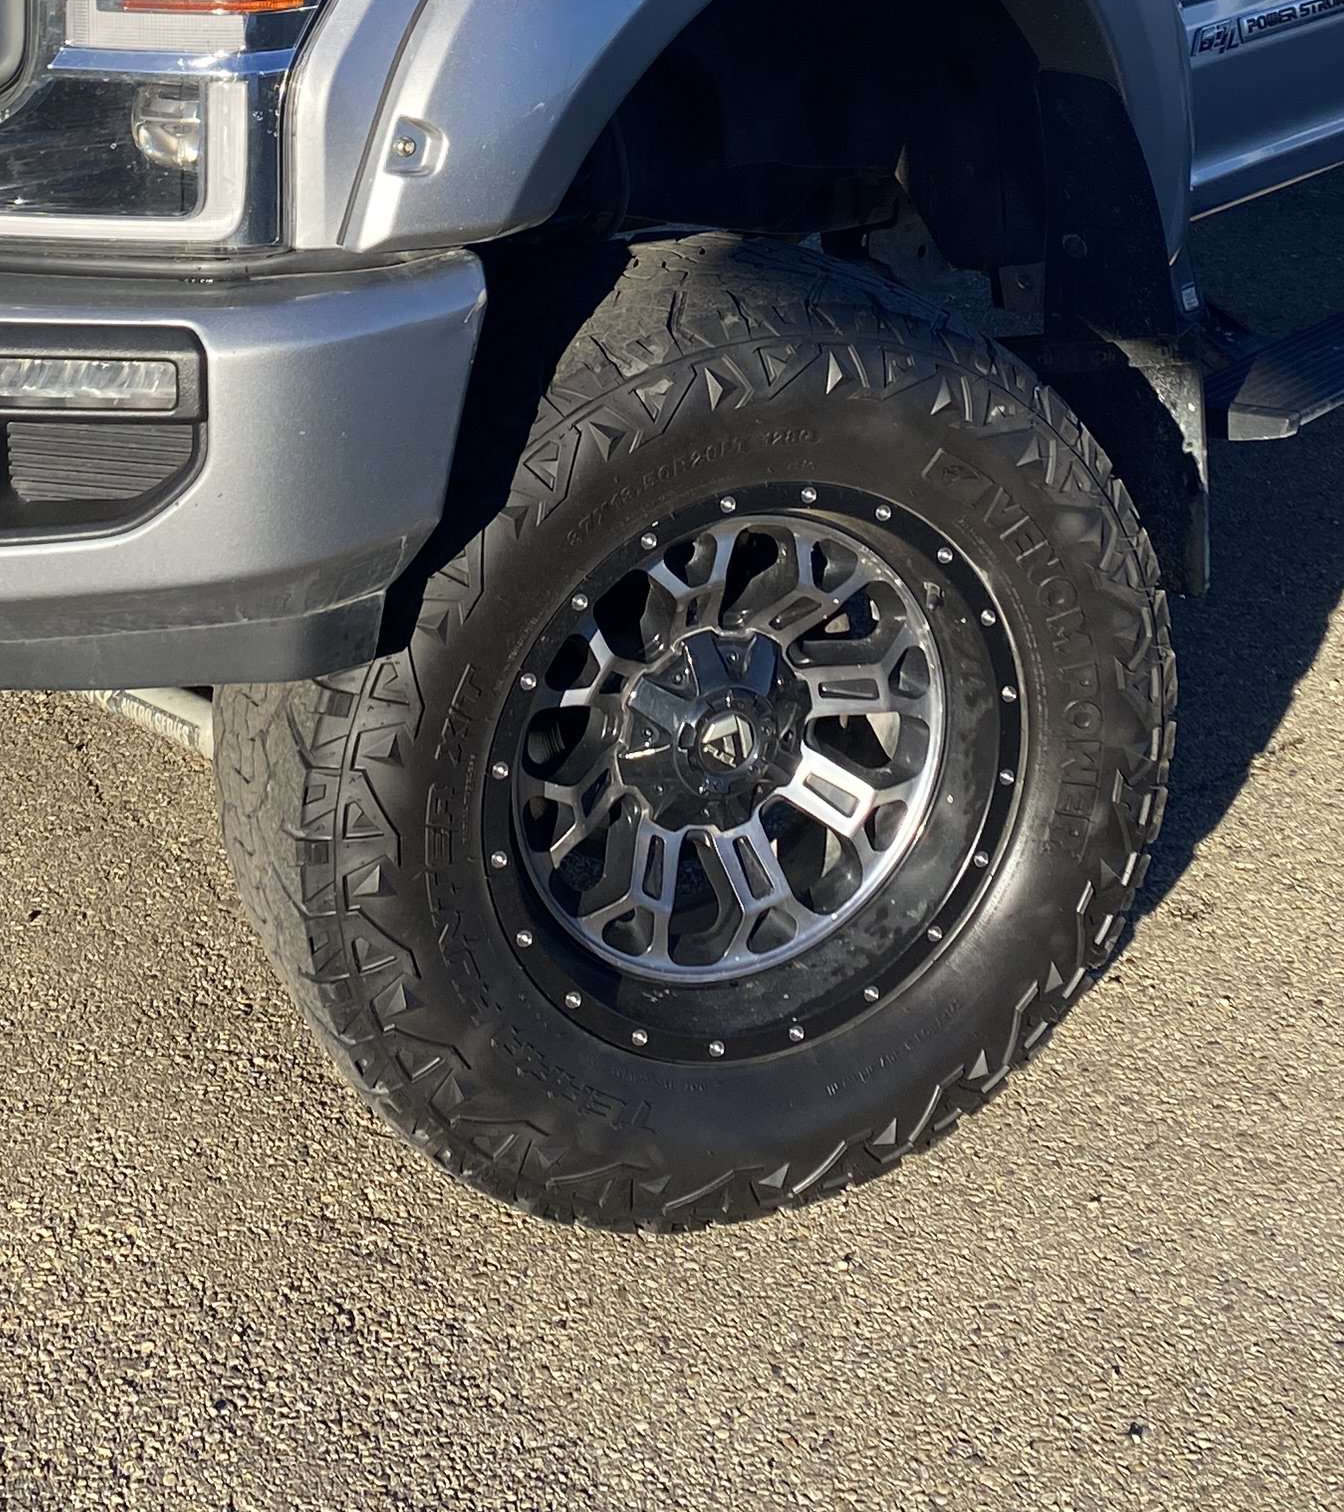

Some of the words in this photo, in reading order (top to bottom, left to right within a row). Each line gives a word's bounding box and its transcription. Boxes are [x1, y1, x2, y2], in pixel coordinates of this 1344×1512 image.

[1246, 6, 1297, 34] POWER
[981, 486, 1086, 655] VENOM
[1052, 660, 1103, 864] POWER
[703, 743, 737, 769] FUEL
